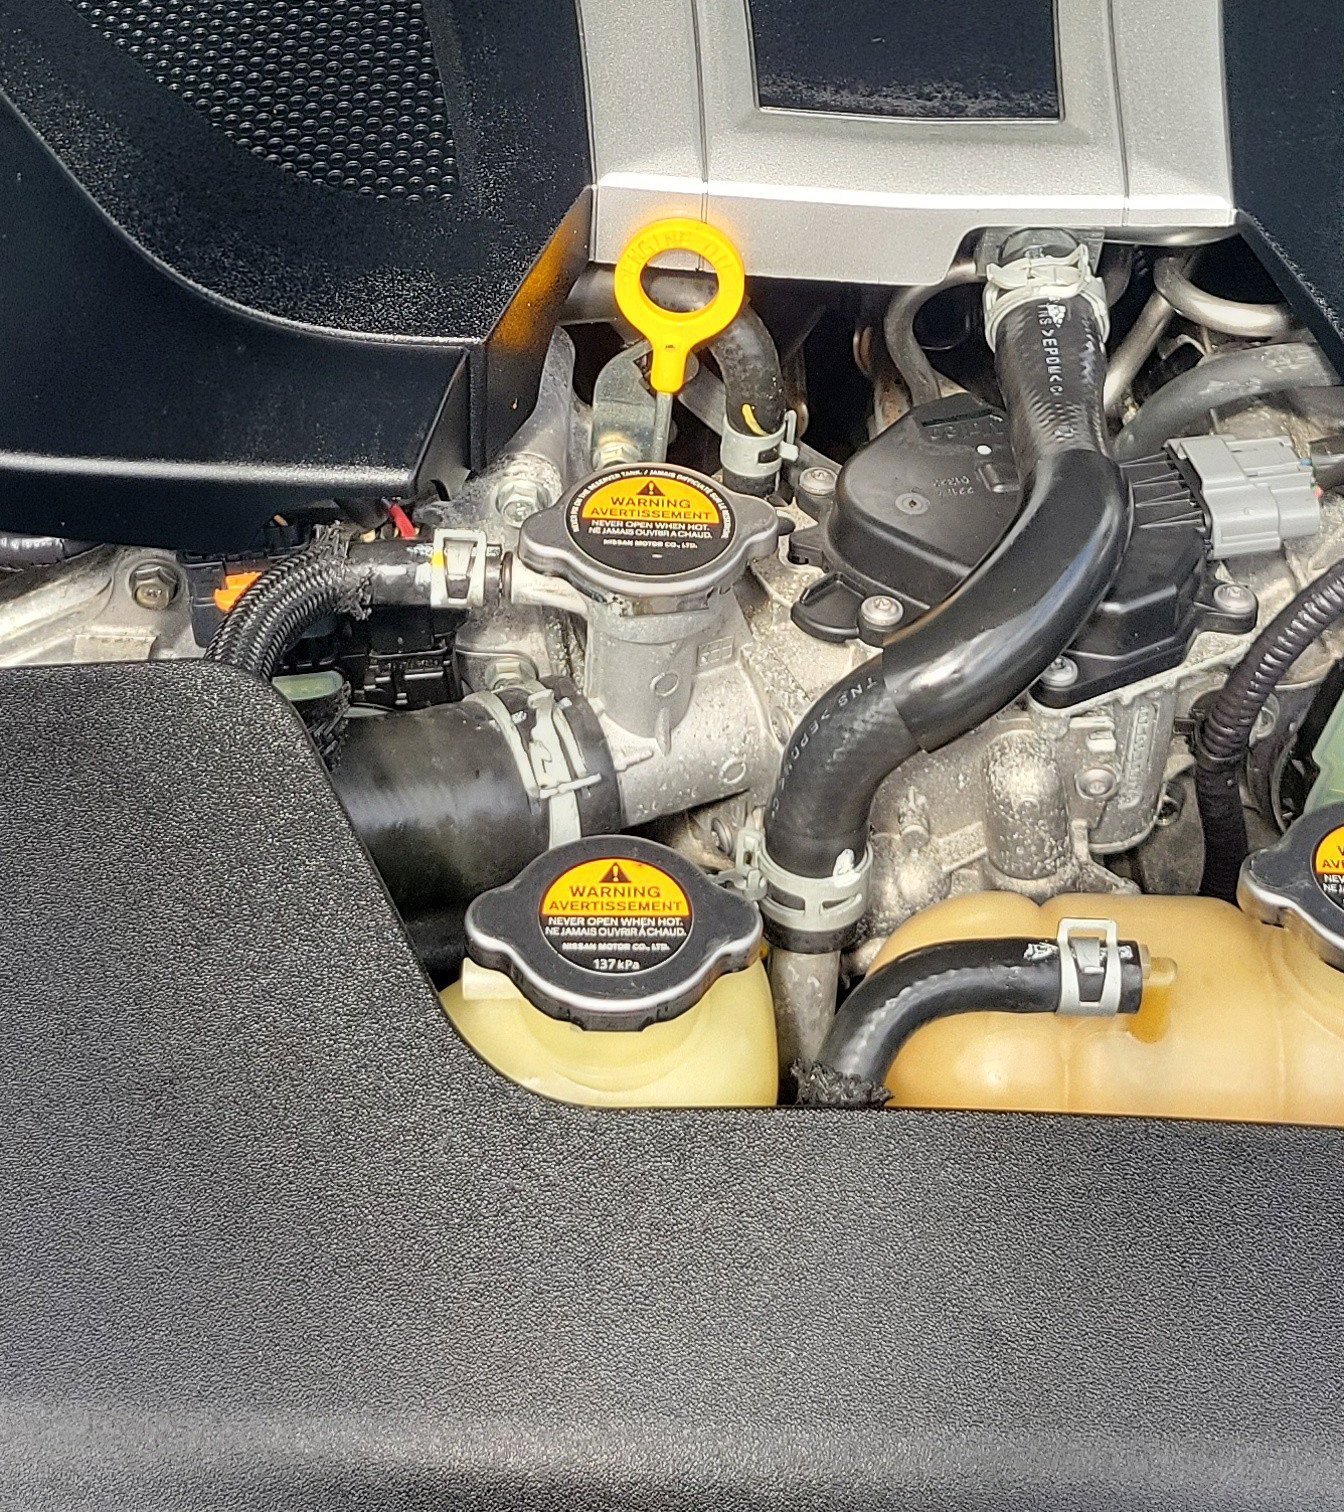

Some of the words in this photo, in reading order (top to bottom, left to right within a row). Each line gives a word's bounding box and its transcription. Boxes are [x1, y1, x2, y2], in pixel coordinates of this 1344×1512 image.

[611, 496, 691, 508] WARNING
[591, 507, 712, 520] AVERTISSEMENT
[591, 519, 623, 527] NEVER
[625, 521, 653, 529] OPEN
[655, 522, 685, 530] WHEN
[687, 523, 710, 531] HOT.
[602, 527, 634, 536] JAMAIS
[635, 528, 670, 537] OUVRIR
[677, 530, 713, 539] CHAUD.
[603, 539, 634, 547] NISSAN
[635, 540, 664, 548] MOTOR
[570, 886, 661, 898] WARNING
[1322, 883, 1337, 892] NE
[549, 900, 682, 912] AVERTISSEMENT
[548, 917, 585, 926] NEVER
[587, 917, 618, 926] OPEN
[620, 917, 656, 927] WHEN
[657, 917, 684, 926] HOT.
[545, 926, 560, 936] NE
[560, 927, 597, 937] JAMAIS
[598, 927, 639, 937] OUVRIR
[646, 927, 687, 937] CHAUD.
[561, 942, 597, 951] NISSAN
[598, 942, 631, 951] MOTOR
[593, 958, 616, 970] 137
[617, 959, 640, 970] kPa
